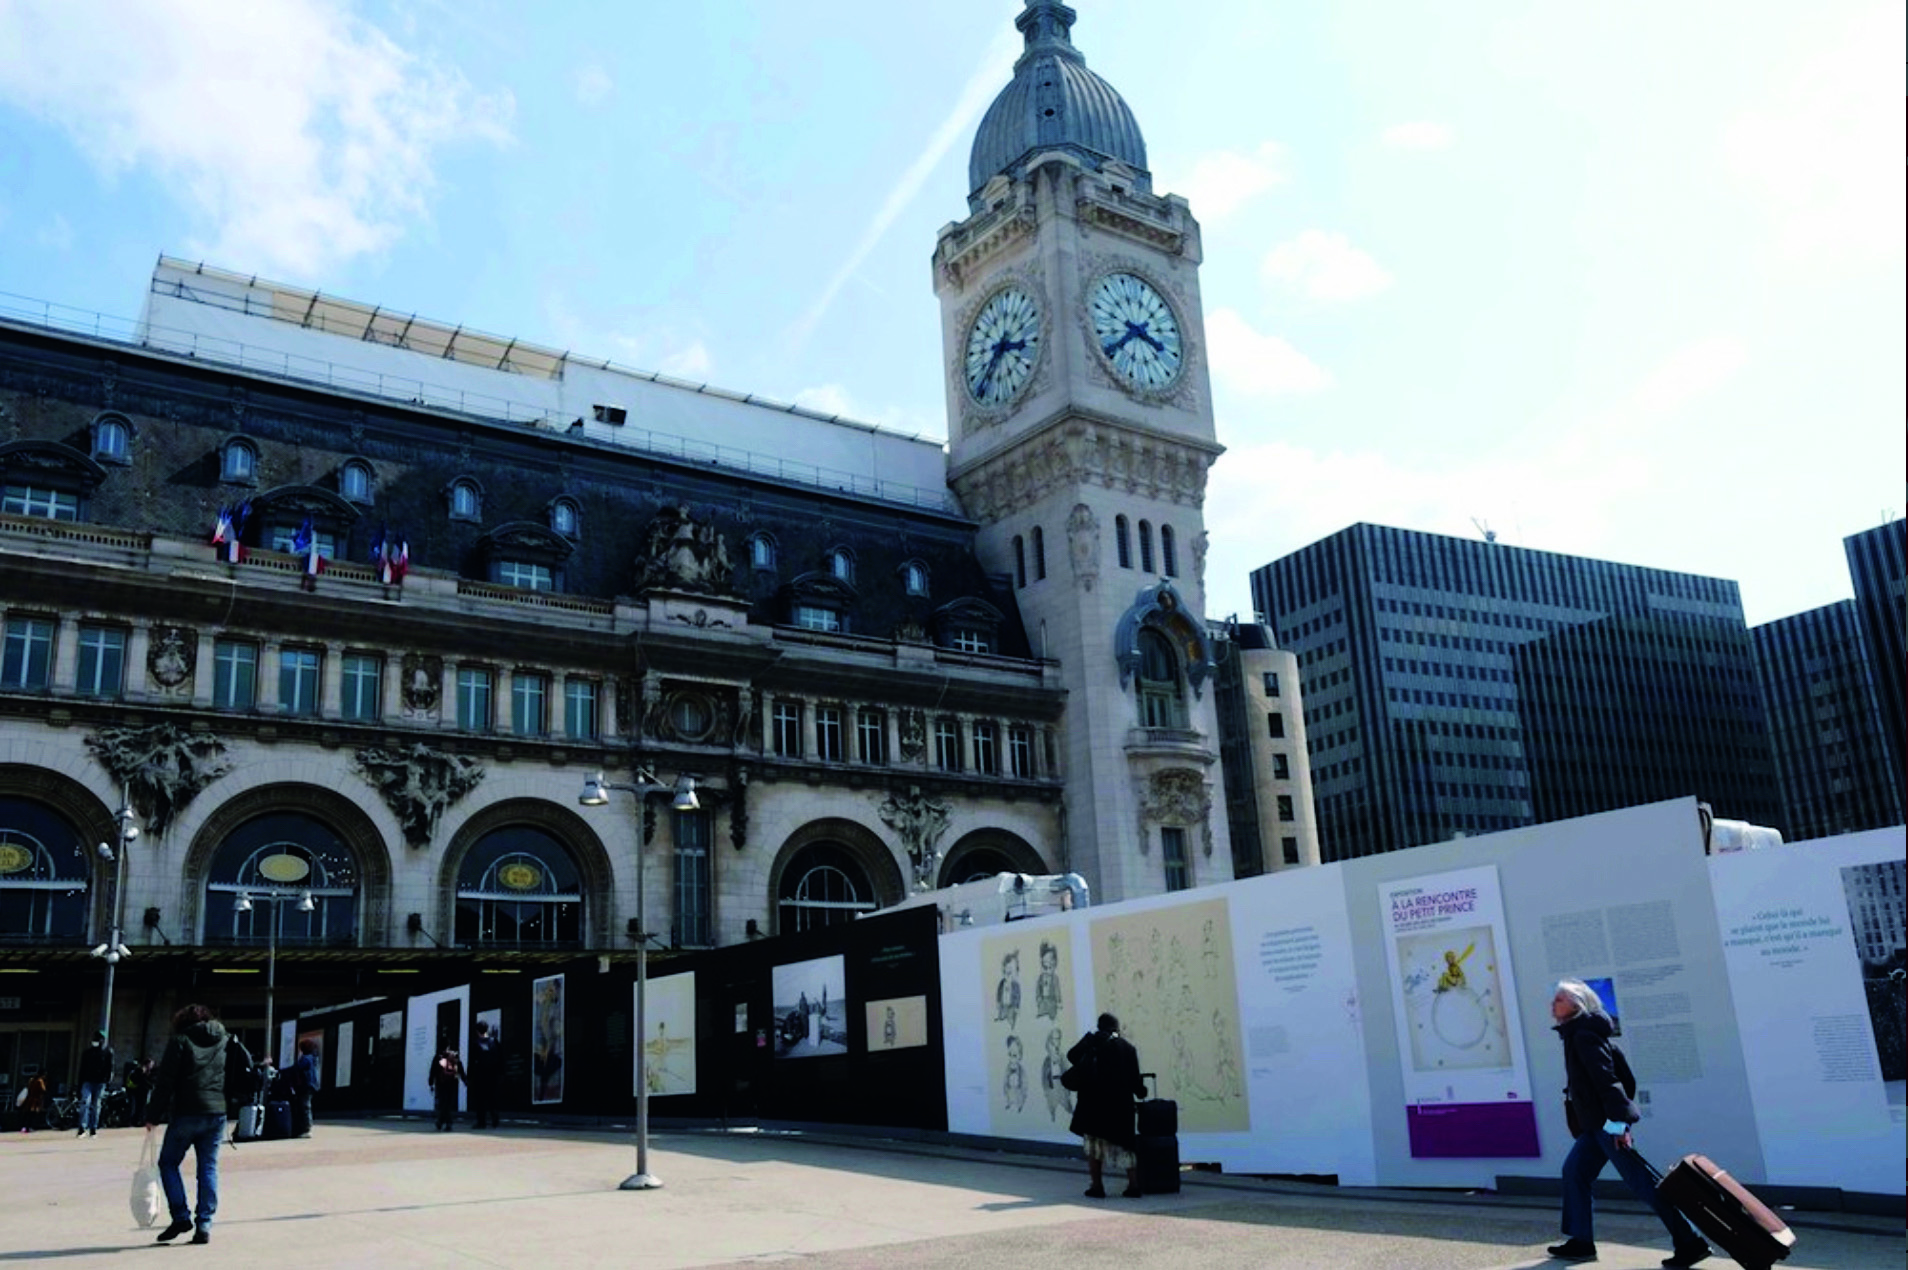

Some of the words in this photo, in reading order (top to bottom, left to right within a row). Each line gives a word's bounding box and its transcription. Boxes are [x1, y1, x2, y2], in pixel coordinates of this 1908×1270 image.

[1401, 898, 1414, 909] LA
[1415, 888, 1477, 905] RENCONTRE
[1393, 911, 1407, 921] DU
[1410, 906, 1435, 919] PETIT
[1438, 901, 1474, 916] PRINCE
